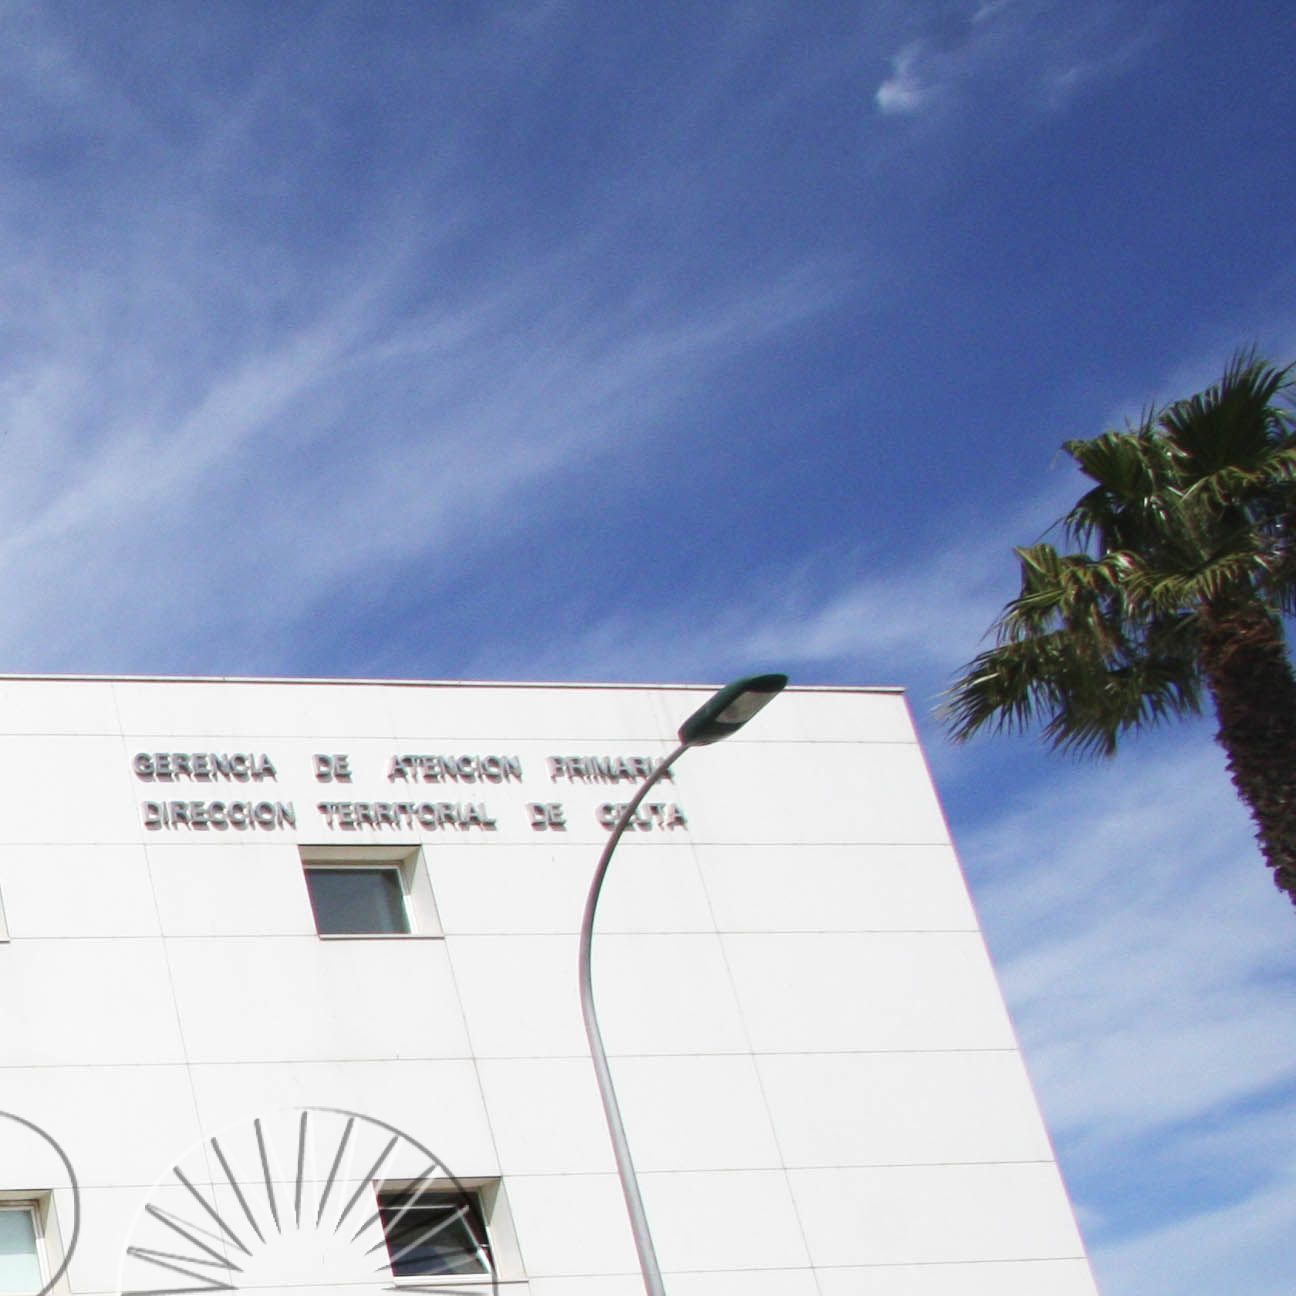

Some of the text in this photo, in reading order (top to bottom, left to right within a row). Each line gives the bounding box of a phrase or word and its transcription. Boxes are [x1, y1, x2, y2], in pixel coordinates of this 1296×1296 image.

[132, 752, 675, 785] GERENCIA DE ATENCION PRIMARIA
[143, 800, 296, 831] DIRECCION
[317, 801, 497, 831] TERRITORIAL
[526, 802, 567, 831] DE
